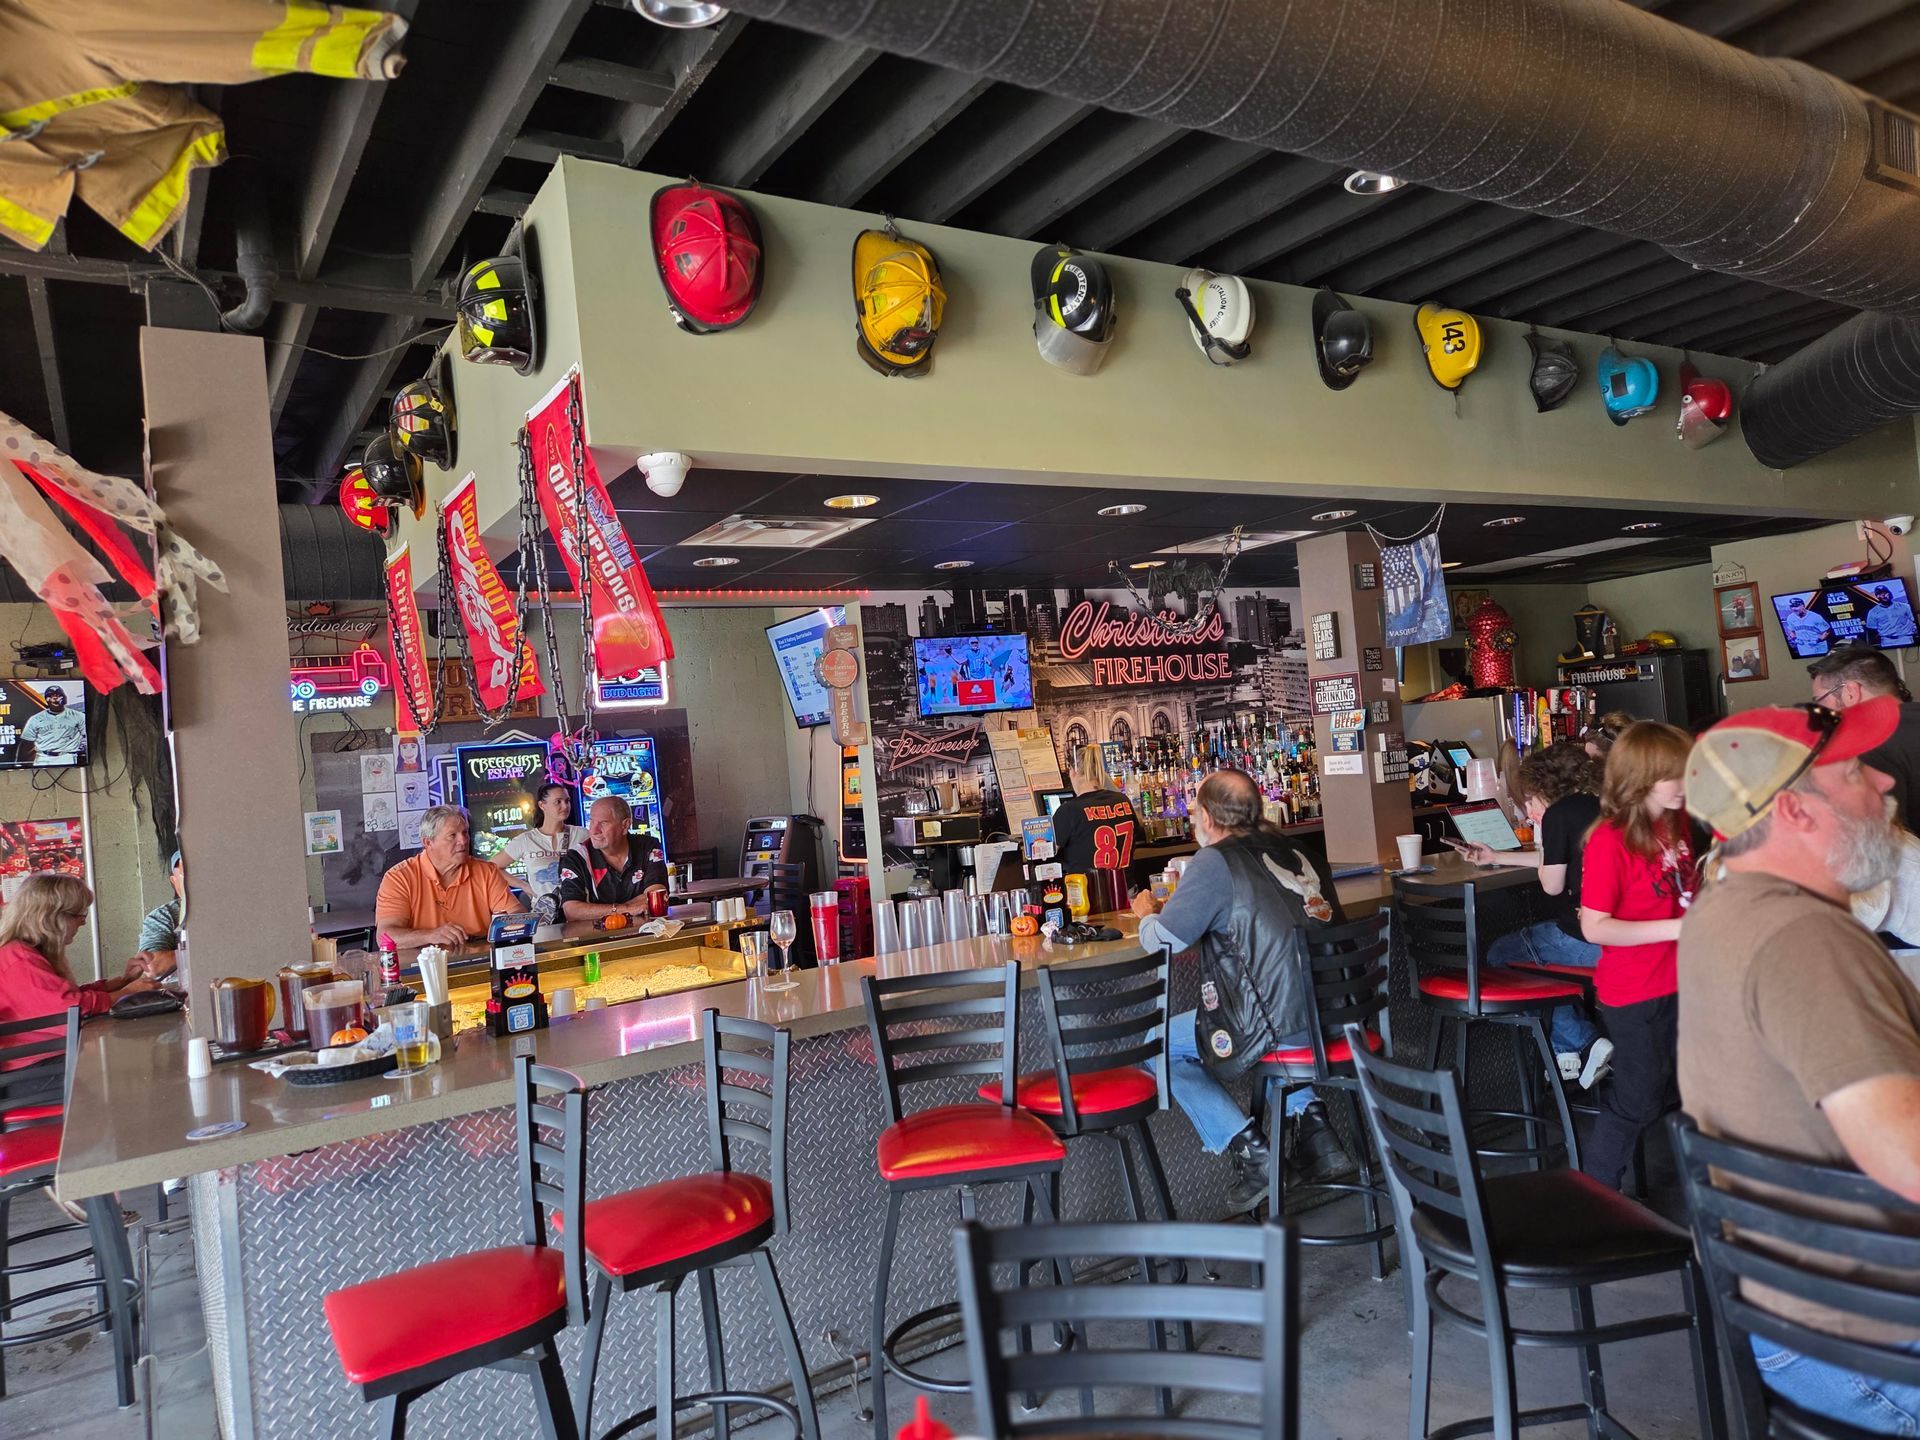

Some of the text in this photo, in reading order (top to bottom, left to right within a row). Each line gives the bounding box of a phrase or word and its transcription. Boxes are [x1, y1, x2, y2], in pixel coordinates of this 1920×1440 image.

[1063, 263, 1088, 316] LIEUTENANT
[1208, 283, 1228, 329] BATTALION CHIEF
[1441, 320, 1466, 355] 143
[461, 493, 481, 550] HOW
[1314, 629, 1334, 643] TEARS
[1389, 626, 1418, 637] VASQUEZ
[1316, 649, 1323, 660] MY
[1093, 653, 1233, 686] FIREHOUSE
[1571, 668, 1627, 685] FIREHOUSE
[603, 687, 660, 699] BUD LIGHT
[1317, 689, 1355, 703] DRINKING
[309, 696, 372, 711] FIREHOUSE
[1334, 717, 1356, 728] BEER
[889, 737, 980, 758] Budweiser
[1390, 750, 1408, 763] STRONG
[467, 754, 543, 779] TREASURE
[487, 766, 525, 780] ESCAPE
[1084, 802, 1132, 821] KELCE
[771, 820, 787, 829] ATM
[1093, 820, 1134, 869] 87
